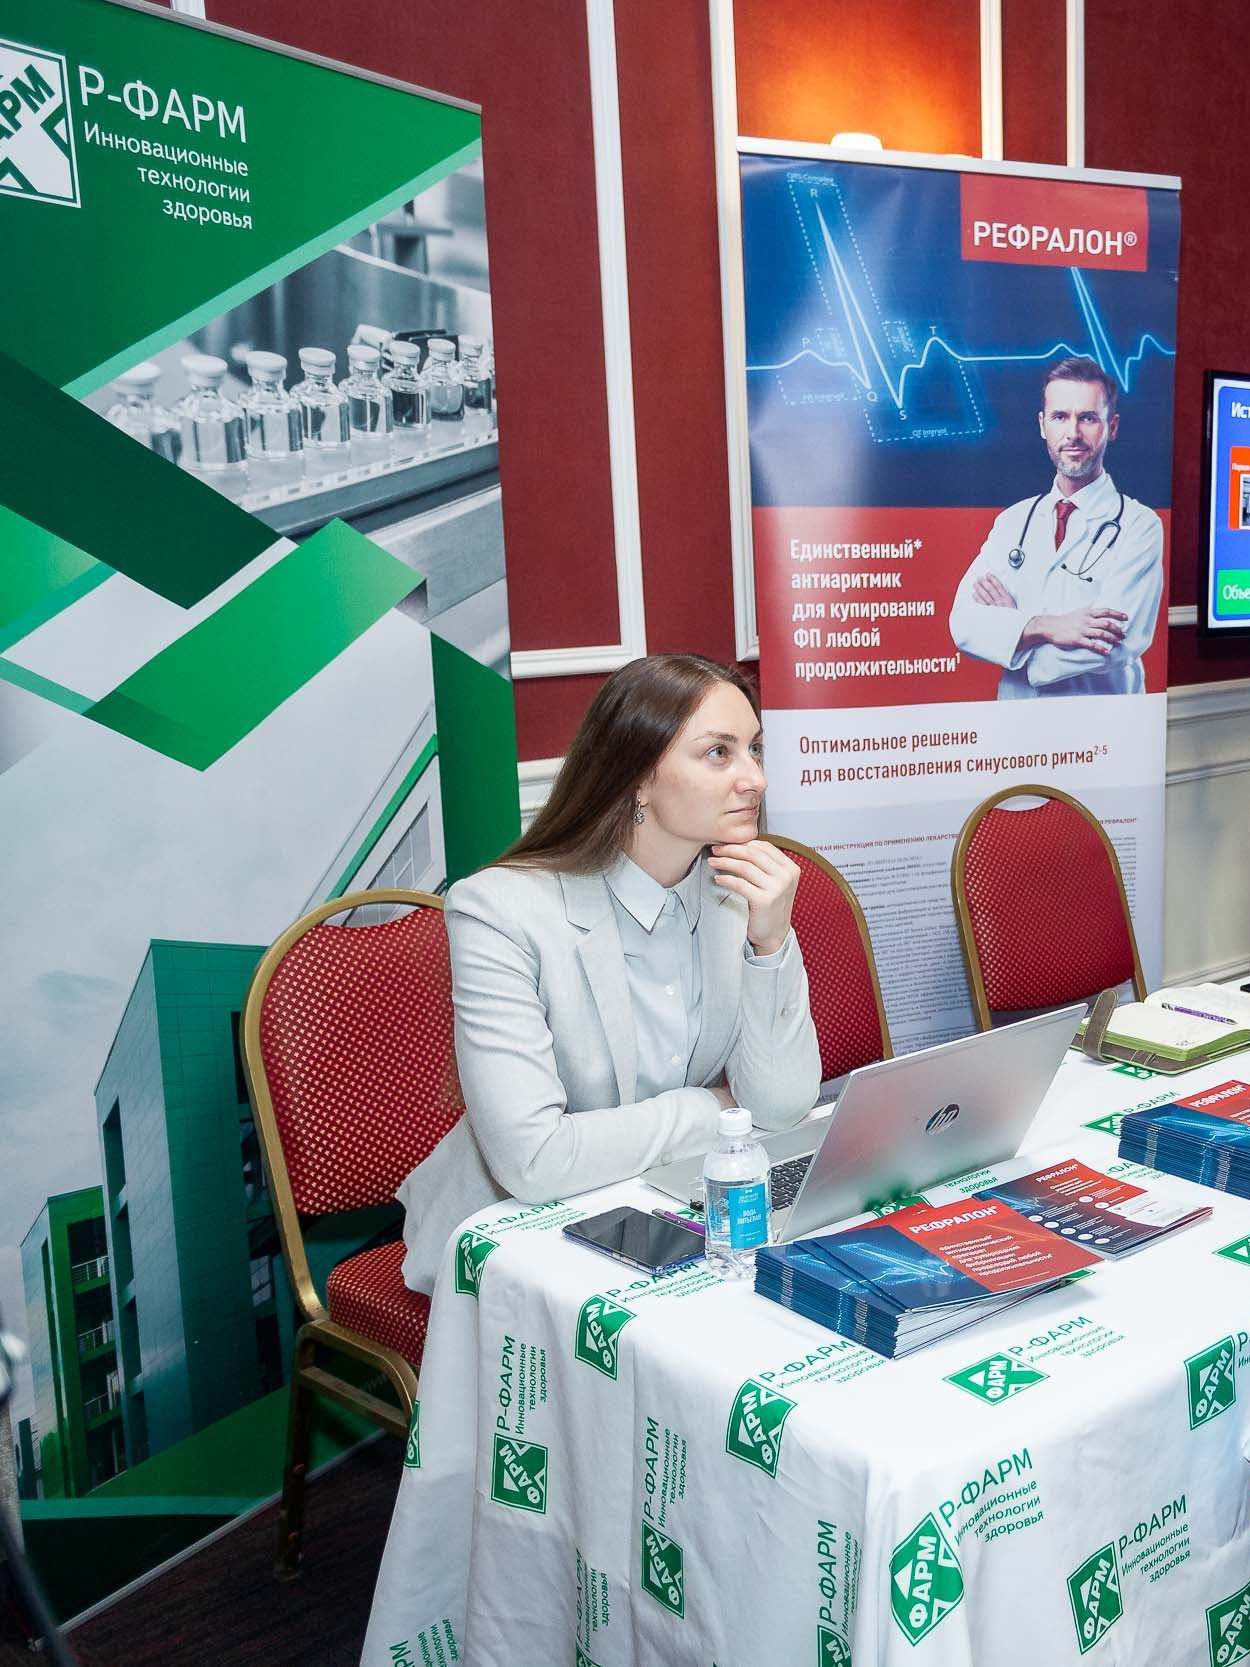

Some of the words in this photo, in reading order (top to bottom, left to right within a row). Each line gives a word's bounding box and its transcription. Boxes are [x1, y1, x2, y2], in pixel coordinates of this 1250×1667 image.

[78, 65, 247, 143] Р-ФАРМ
[84, 120, 249, 176] Инновационные
[137, 166, 250, 203] технологии
[810, 188, 818, 198] R
[162, 199, 253, 229] здоровья
[973, 220, 1137, 256] РЕФРАЛОН®
[801, 336, 810, 348] P
[929, 326, 937, 335] T
[866, 391, 877, 401] Q
[899, 410, 907, 420] S
[791, 573, 902, 592] антиаритмик
[793, 604, 826, 622] для
[830, 600, 935, 623] купирования
[794, 628, 822, 648] ФП
[826, 627, 881, 648] любой
[799, 736, 907, 755] Оптимальное
[911, 730, 978, 750] решение
[800, 765, 832, 786] для
[837, 758, 962, 782] восстановления
[966, 753, 1048, 775] синусового
[833, 840, 874, 851] ИНСТРУКЦИЯ
[884, 837, 925, 847] ПРИМЕНЕНИЮ
[928, 1104, 959, 1131] hp
[944, 1168, 991, 1189] технологии
[959, 1176, 999, 1194] здоровья
[474, 1201, 565, 1231] Р-ФАРМ
[606, 1262, 700, 1298] Р-ФАРМ
[586, 1303, 613, 1369] ФАРМ
[1008, 1315, 1094, 1357] Р-ФАРМ
[529, 1345, 537, 1411] технологии
[539, 1348, 547, 1403] здоровья
[759, 1340, 856, 1382] Р-ФАРМ
[776, 1350, 868, 1389] Инновационные
[814, 1354, 877, 1384] технологии
[834, 1358, 887, 1384] здоровья
[985, 1360, 1009, 1399] ФАРМ
[496, 1335, 516, 1431] Р-ФАРМ
[515, 1343, 527, 1435] Инновационные
[1195, 1349, 1231, 1418] ФАРМ
[742, 1390, 773, 1465] ФАРМ
[498, 1444, 541, 1504] ФАРМ
[643, 1416, 660, 1521] Р-ФАРМ
[658, 1427, 671, 1529] Инновационные
[670, 1433, 679, 1505] технологии
[678, 1439, 688, 1500] здоровья
[938, 1448, 1033, 1528] Р-ФАРМ
[954, 1480, 1038, 1547] Инновационные
[974, 1495, 1041, 1539] технологии
[984, 1510, 1044, 1543] здоровья
[1118, 1494, 1187, 1559] Р-ФАРМ
[646, 1532, 680, 1606] ФАРМ
[1121, 1522, 1189, 1577] Инновационные
[1140, 1537, 1190, 1576] технологии
[1149, 1550, 1191, 1583] здоровья
[817, 1519, 837, 1626] Р-ФАРМ
[841, 1531, 852, 1637] Инновационные
[909, 1535, 937, 1628] ФАРМ
[600, 1572, 610, 1627] здоровья
[1083, 1558, 1111, 1640] ФАРМ
